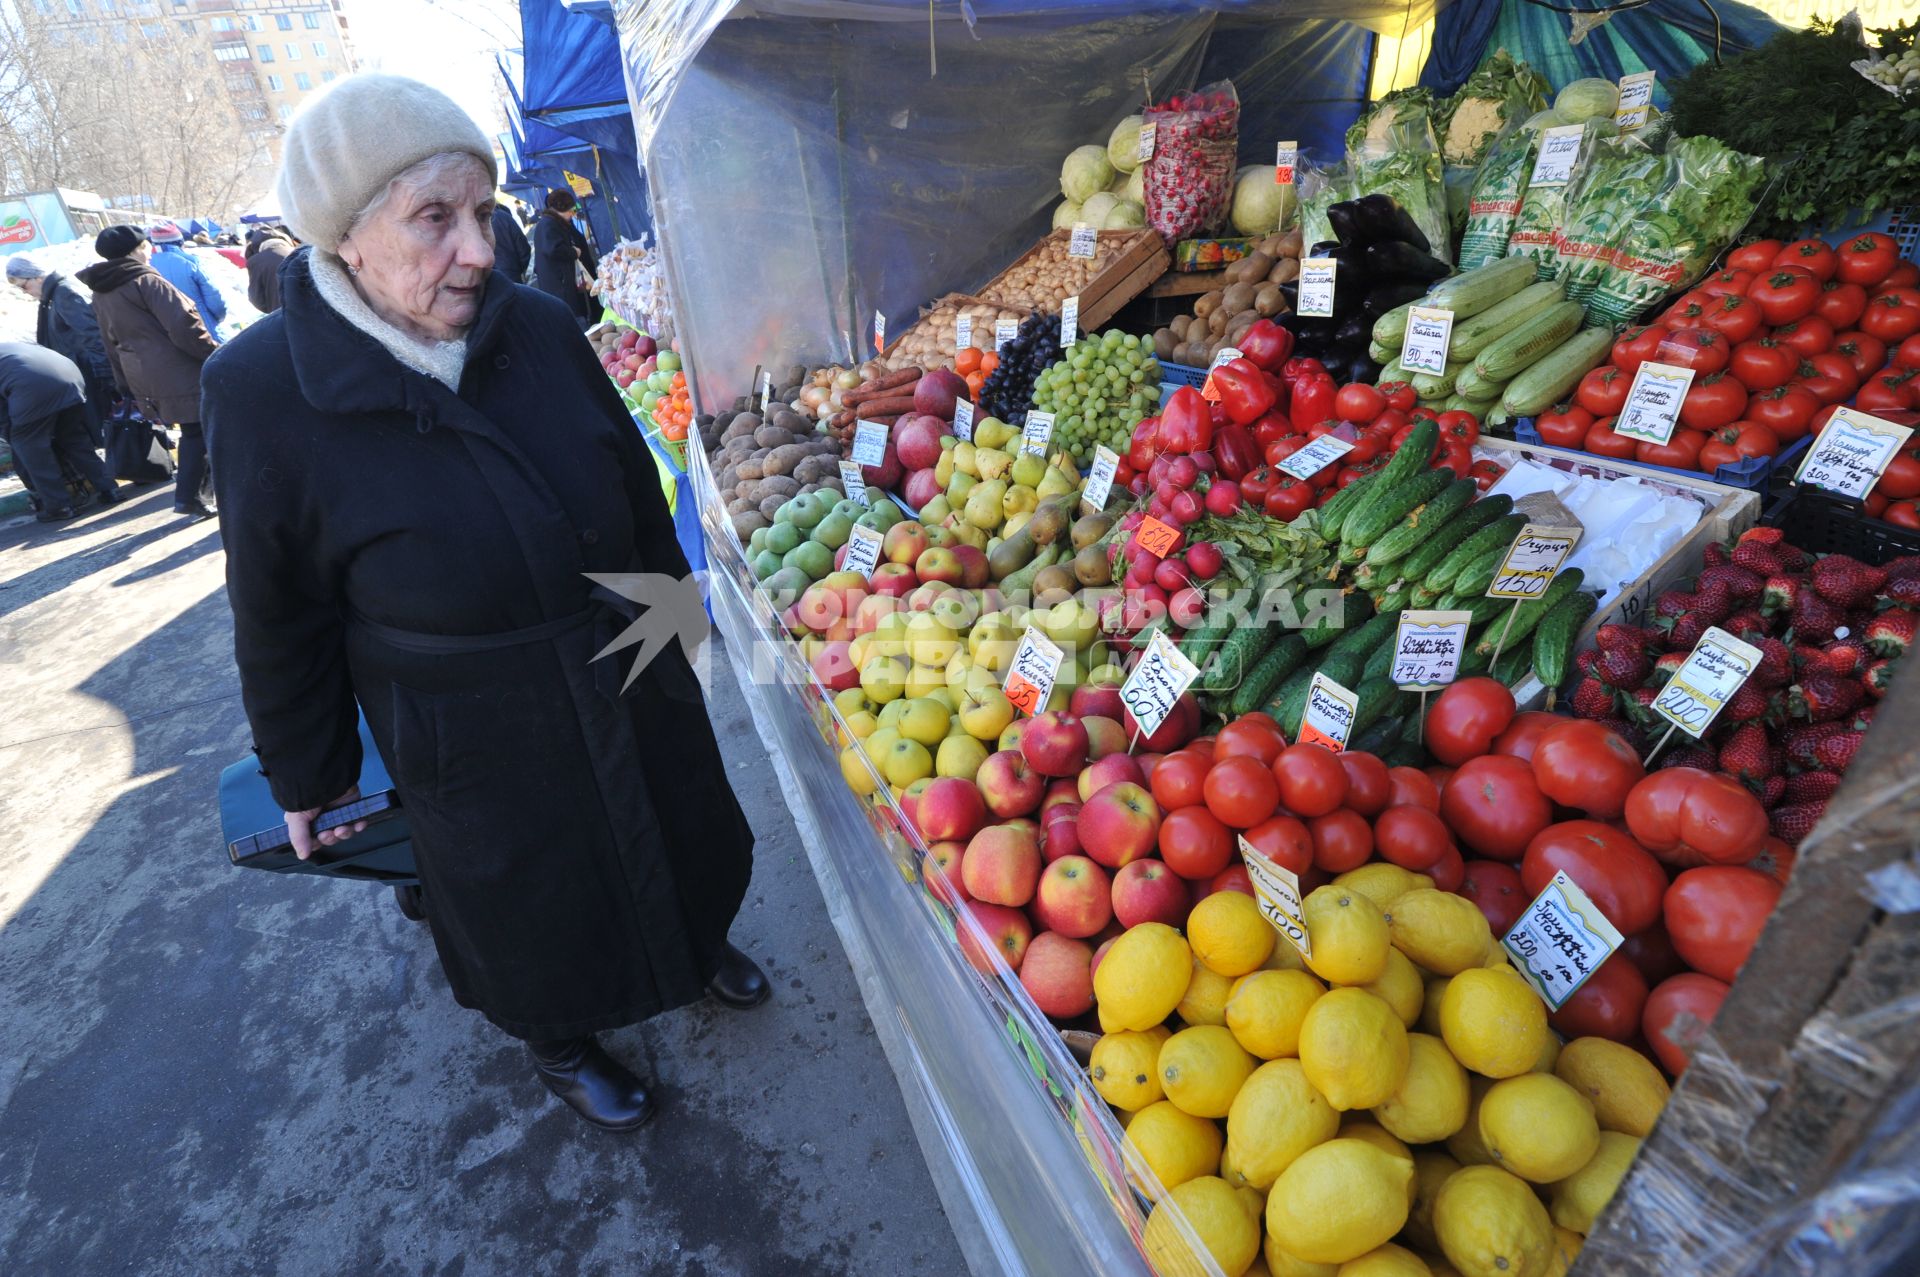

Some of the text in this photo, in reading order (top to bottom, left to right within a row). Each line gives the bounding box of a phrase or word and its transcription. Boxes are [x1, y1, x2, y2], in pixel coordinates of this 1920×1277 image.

[1406, 348, 1421, 362] 90
[1806, 467, 1830, 482] 200
[1497, 571, 1546, 595] 150
[1396, 666, 1426, 679] 170
[1008, 683, 1037, 707] 55
[1126, 687, 1154, 717] 60
[1659, 686, 1708, 724] 200
[1263, 903, 1304, 940] 100
[1509, 931, 1538, 957] 200
